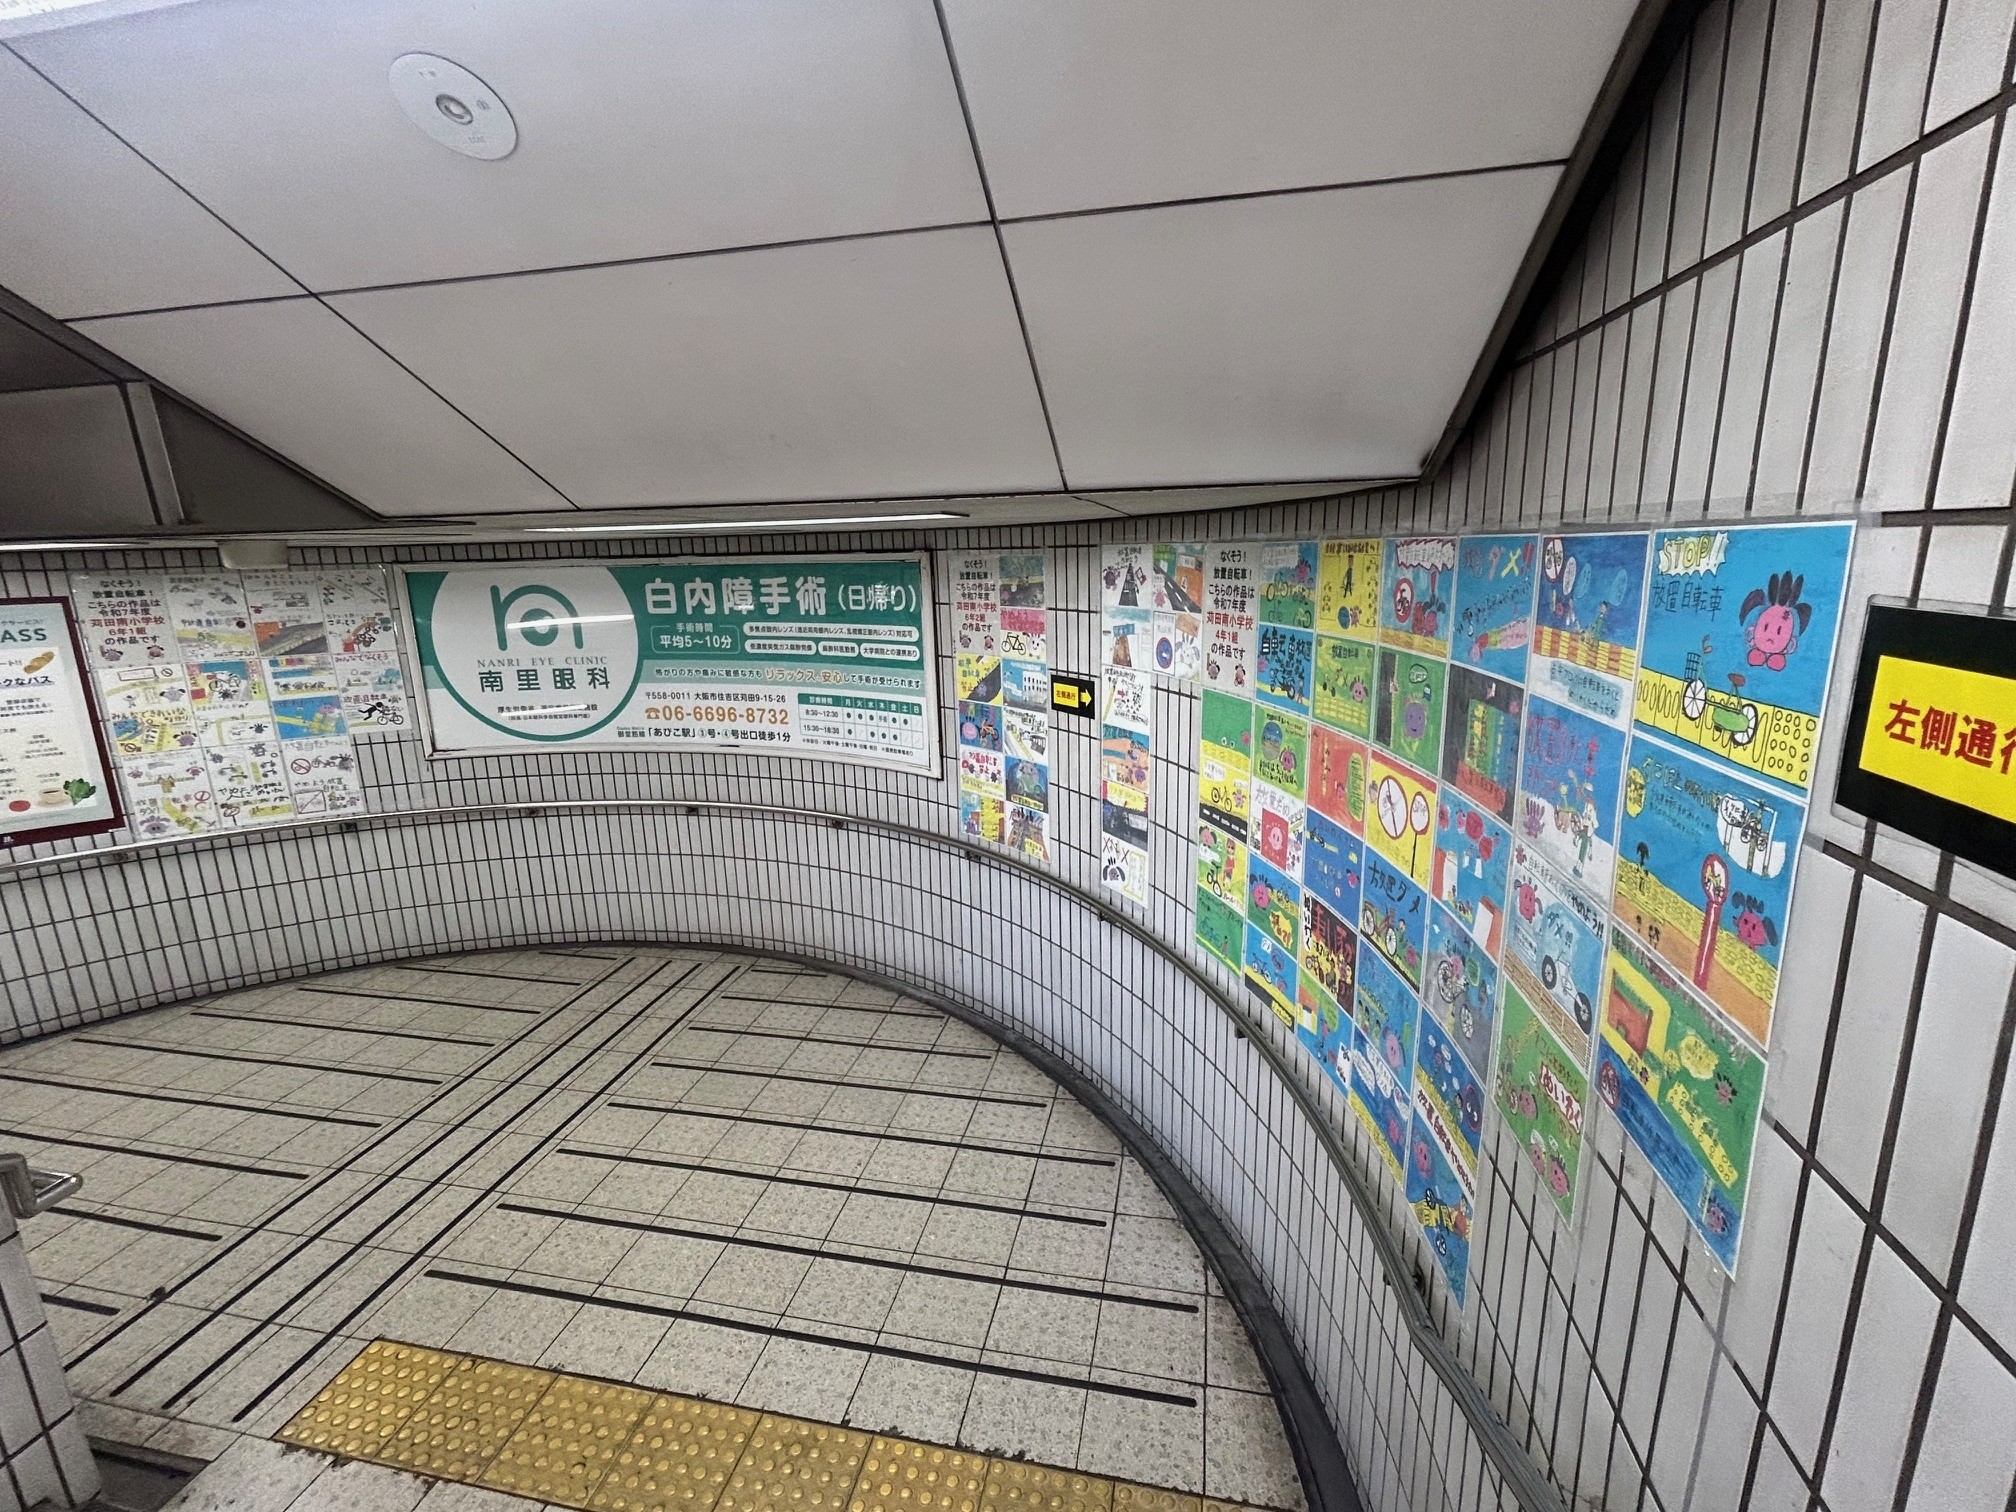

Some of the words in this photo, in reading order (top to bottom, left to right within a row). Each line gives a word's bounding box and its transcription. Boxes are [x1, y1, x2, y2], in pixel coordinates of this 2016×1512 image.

[1220, 550, 1247, 563] なくそう！
[1213, 567, 1252, 580] 放置自転車！
[956, 582, 997, 592] こちらの作品は
[1208, 583, 1255, 599] こちらの作品は
[645, 576, 827, 616] 白内障手術
[88, 599, 162, 609] こちらの作品は
[1213, 597, 1247, 613] 令和7年度
[676, 622, 714, 633] 手術時間
[961, 623, 993, 633] の作品です
[1206, 611, 1254, 631] 苅田南小学校
[1, 628, 48, 643] ASS
[104, 636, 160, 646] の作品です
[1215, 629, 1239, 645] 4年1組
[1211, 643, 1246, 661] の作品です
[477, 658, 521, 668] NANRI
[531, 657, 555, 667] EYE
[564, 656, 608, 666] CLINIC
[478, 667, 611, 693] 南里眼科
[662, 705, 789, 725] 06-6696-8732
